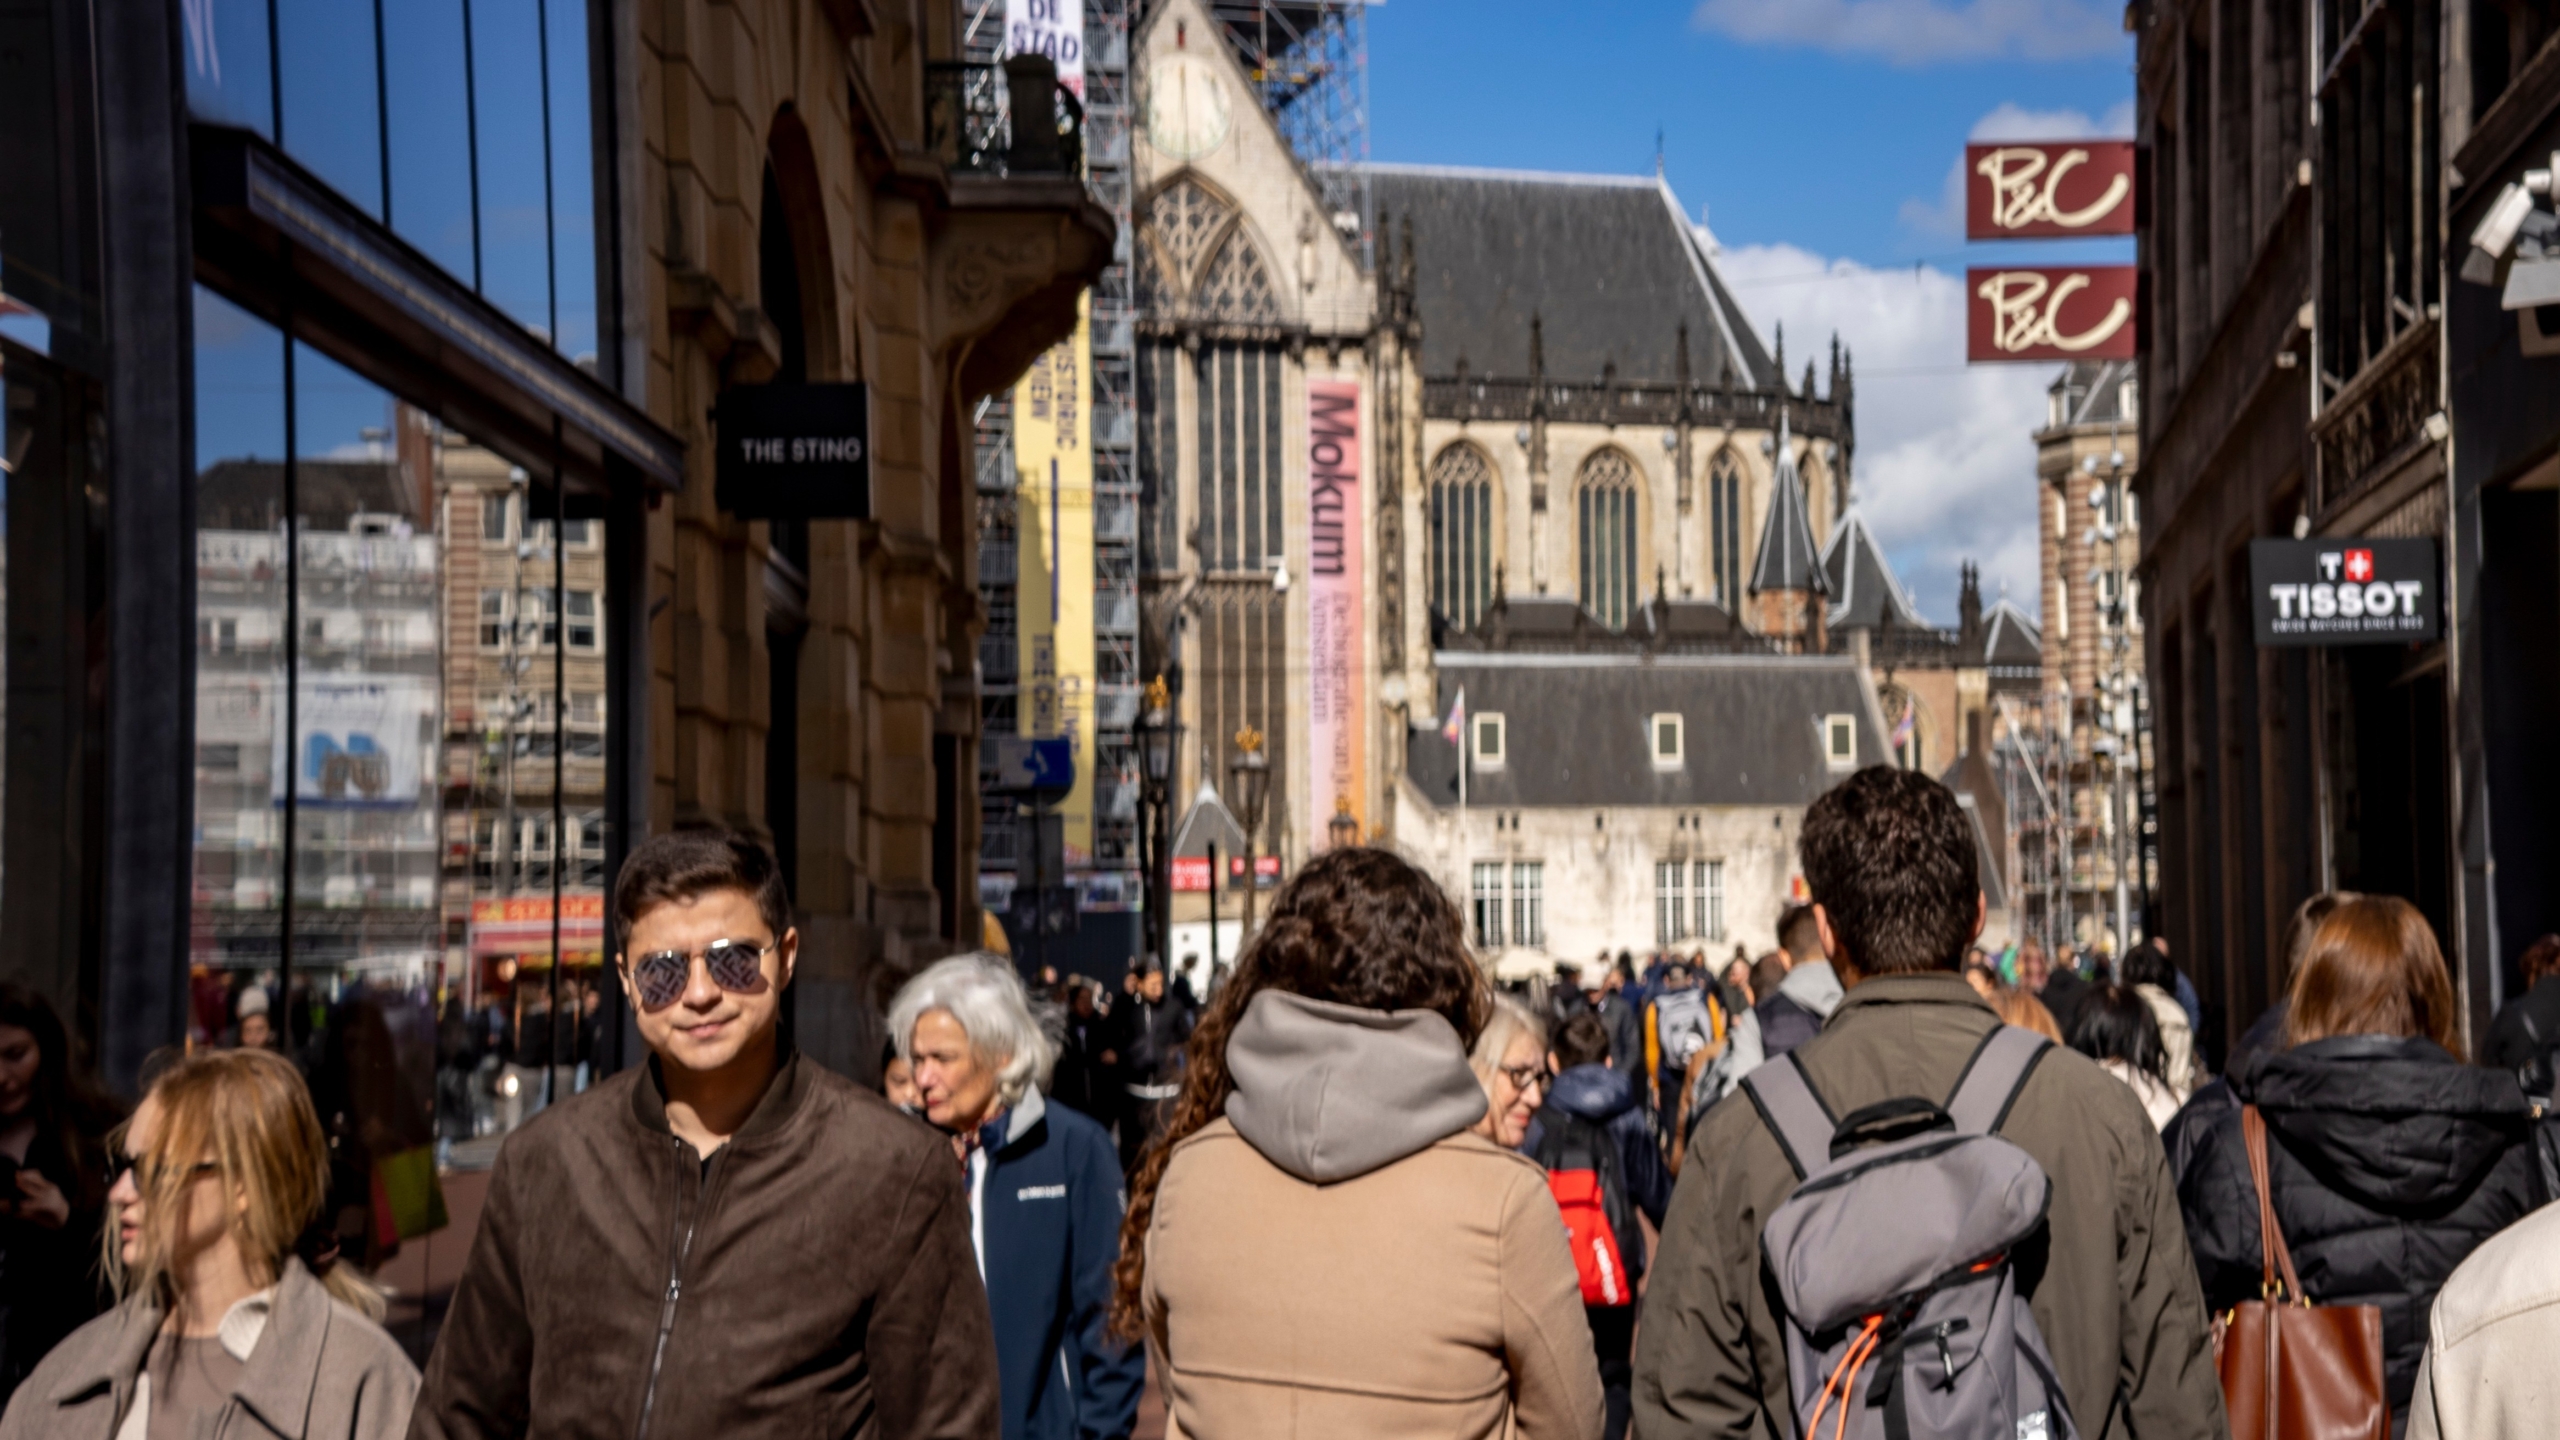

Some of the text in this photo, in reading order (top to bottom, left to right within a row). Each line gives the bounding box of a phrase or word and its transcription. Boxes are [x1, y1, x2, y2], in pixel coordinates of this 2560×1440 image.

[1028, 0, 1061, 24] DE
[1012, 20, 1079, 62] STAD
[1055, 334, 1077, 450] ISTORIC
[741, 437, 786, 464] THE
[1310, 393, 1356, 576] Mokum
[2269, 580, 2423, 619] TISSOT
